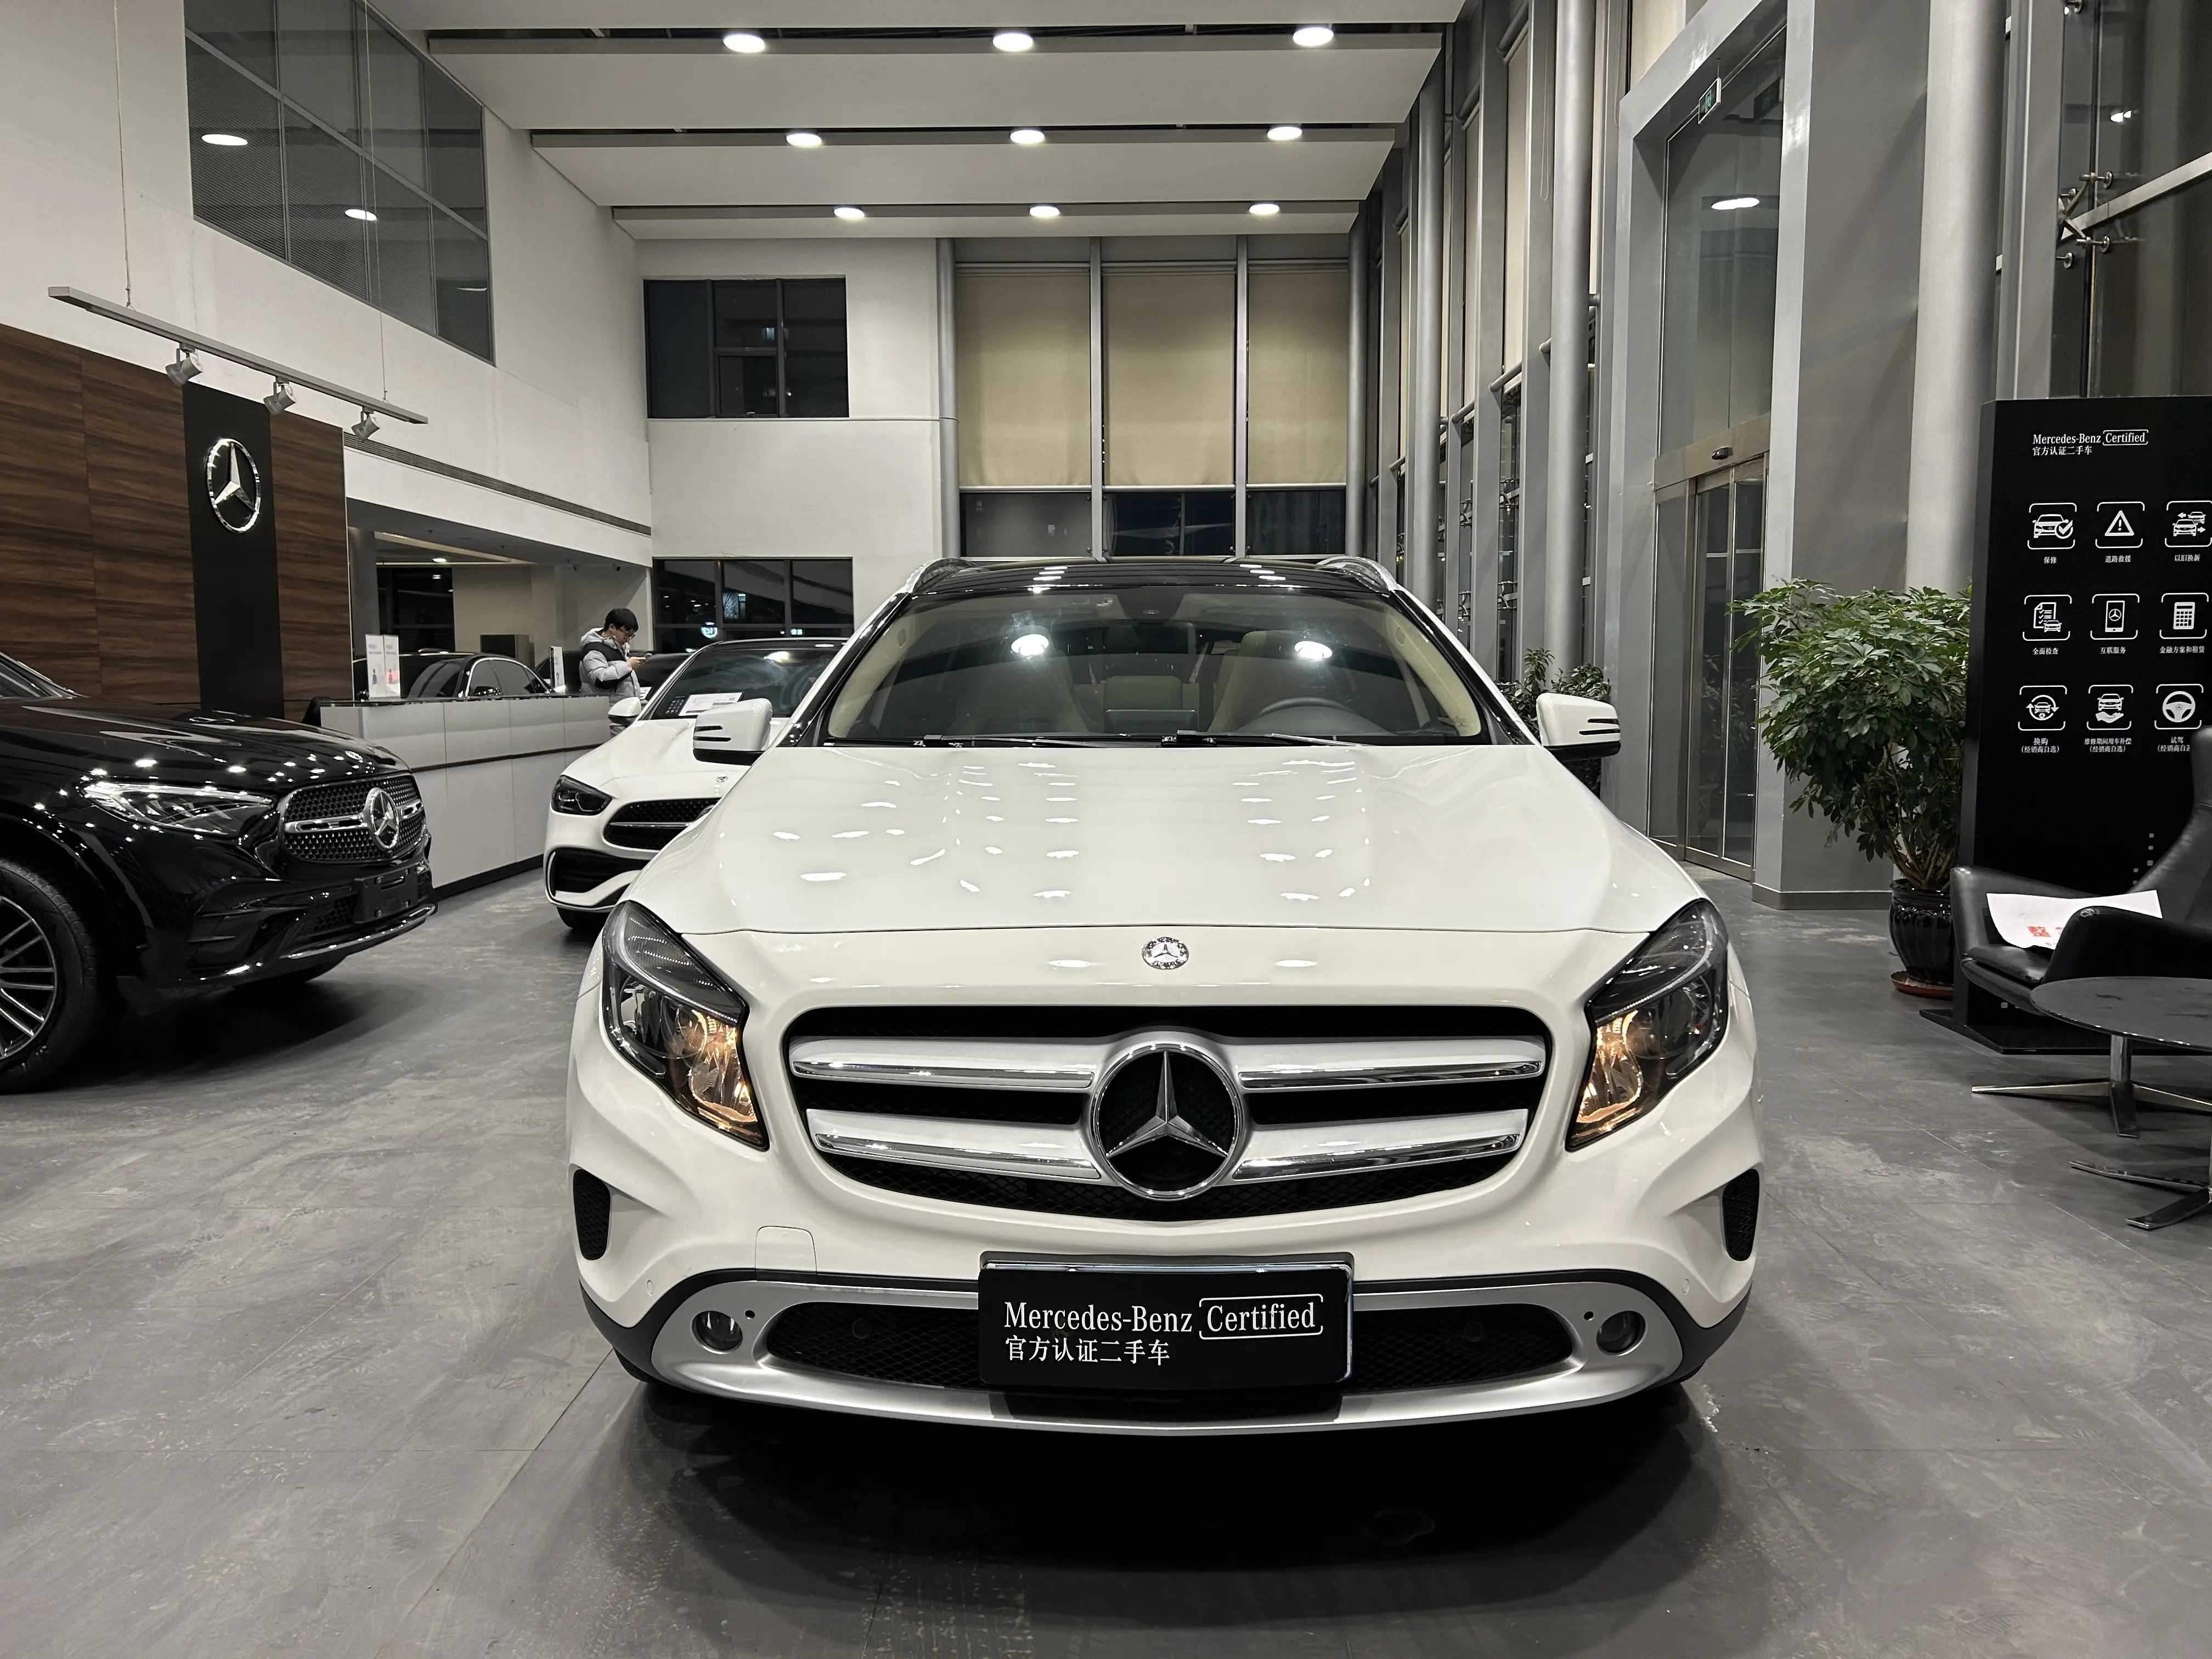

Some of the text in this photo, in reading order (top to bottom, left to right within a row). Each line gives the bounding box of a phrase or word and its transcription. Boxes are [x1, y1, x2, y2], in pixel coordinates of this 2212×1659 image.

[2032, 431, 2146, 445] Mercedes-Benz Certified
[2032, 445, 2093, 456] 官方认证二手车
[2044, 556, 2057, 565] 保修
[2104, 555, 2132, 564] 道路救援
[2174, 553, 2201, 562] 以旧换新
[2032, 647, 2059, 656] 全面检查
[2100, 646, 2126, 654] 互联服务
[2159, 645, 2205, 654] 金融方案和租赁
[1004, 1301, 1316, 1333] Mercedes-Benz Certified
[1005, 1335, 1170, 1366] 官方认证二手车
